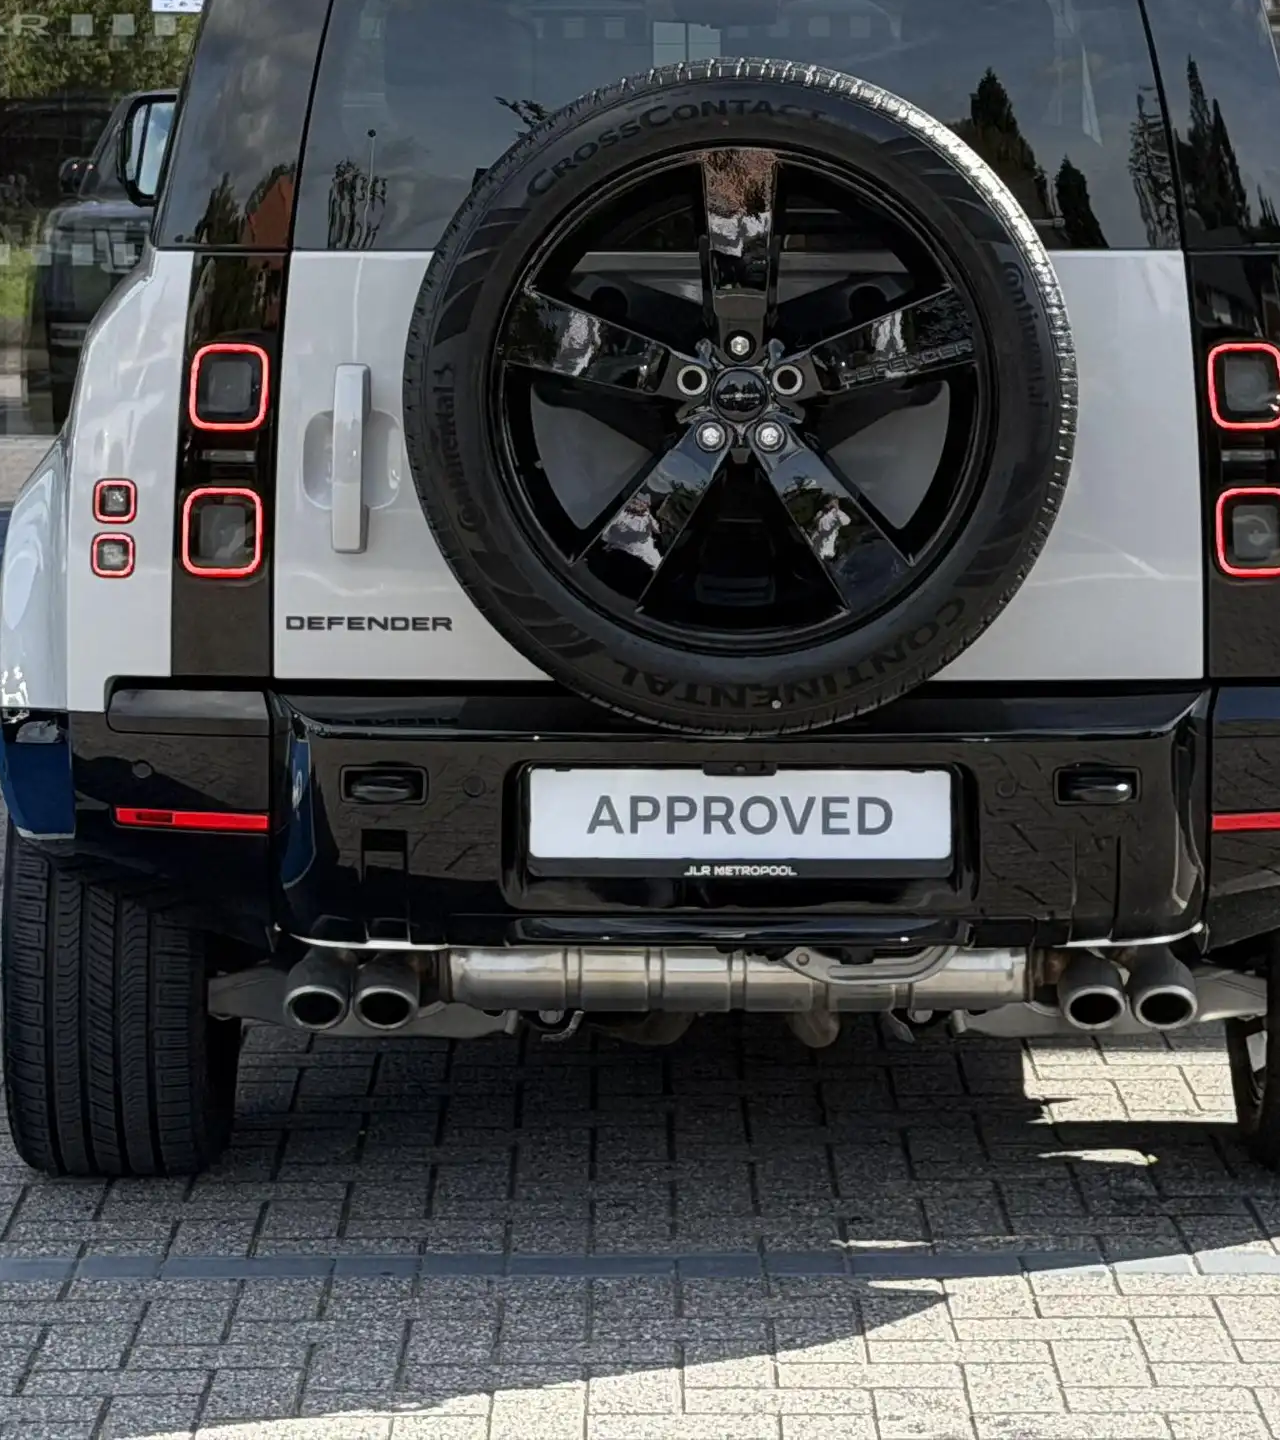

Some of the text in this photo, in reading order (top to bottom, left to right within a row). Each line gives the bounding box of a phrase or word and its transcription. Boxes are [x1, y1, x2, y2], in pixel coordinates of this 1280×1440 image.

[286, 615, 453, 632] DEFENDER
[614, 595, 969, 711] CONTINENTAL
[586, 794, 894, 836] APPROVED
[684, 865, 798, 877] JLR METROPOOL
